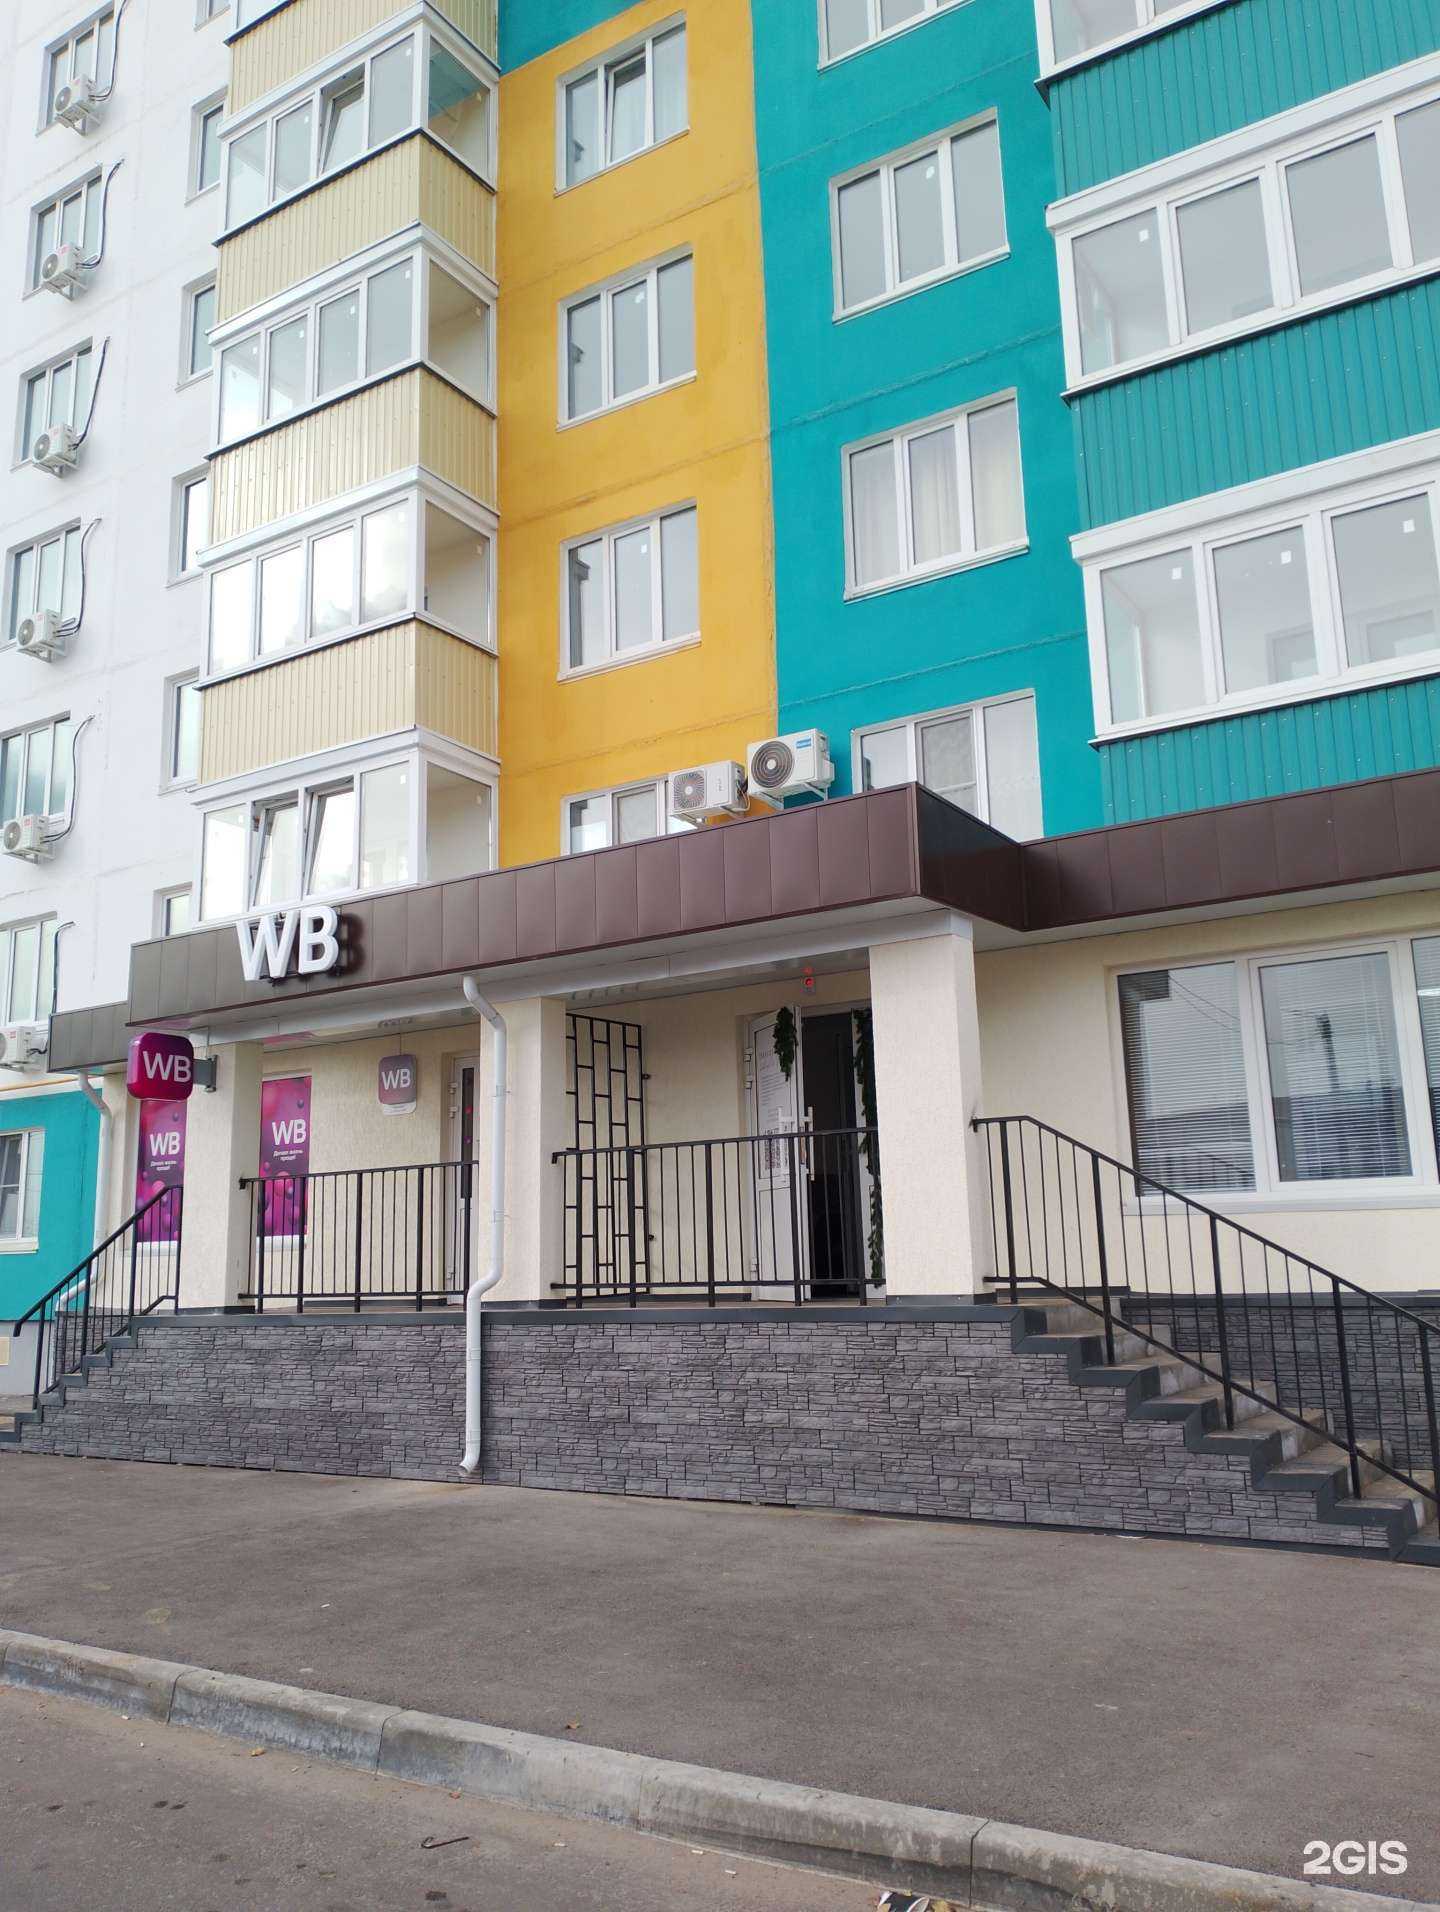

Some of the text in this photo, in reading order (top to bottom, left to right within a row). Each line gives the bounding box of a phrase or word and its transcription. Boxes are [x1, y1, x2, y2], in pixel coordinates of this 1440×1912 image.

[236, 905, 339, 981] WB
[143, 1050, 191, 1082] WB
[381, 1068, 410, 1090] WB
[149, 1131, 180, 1156] WB
[271, 1119, 306, 1145] WB
